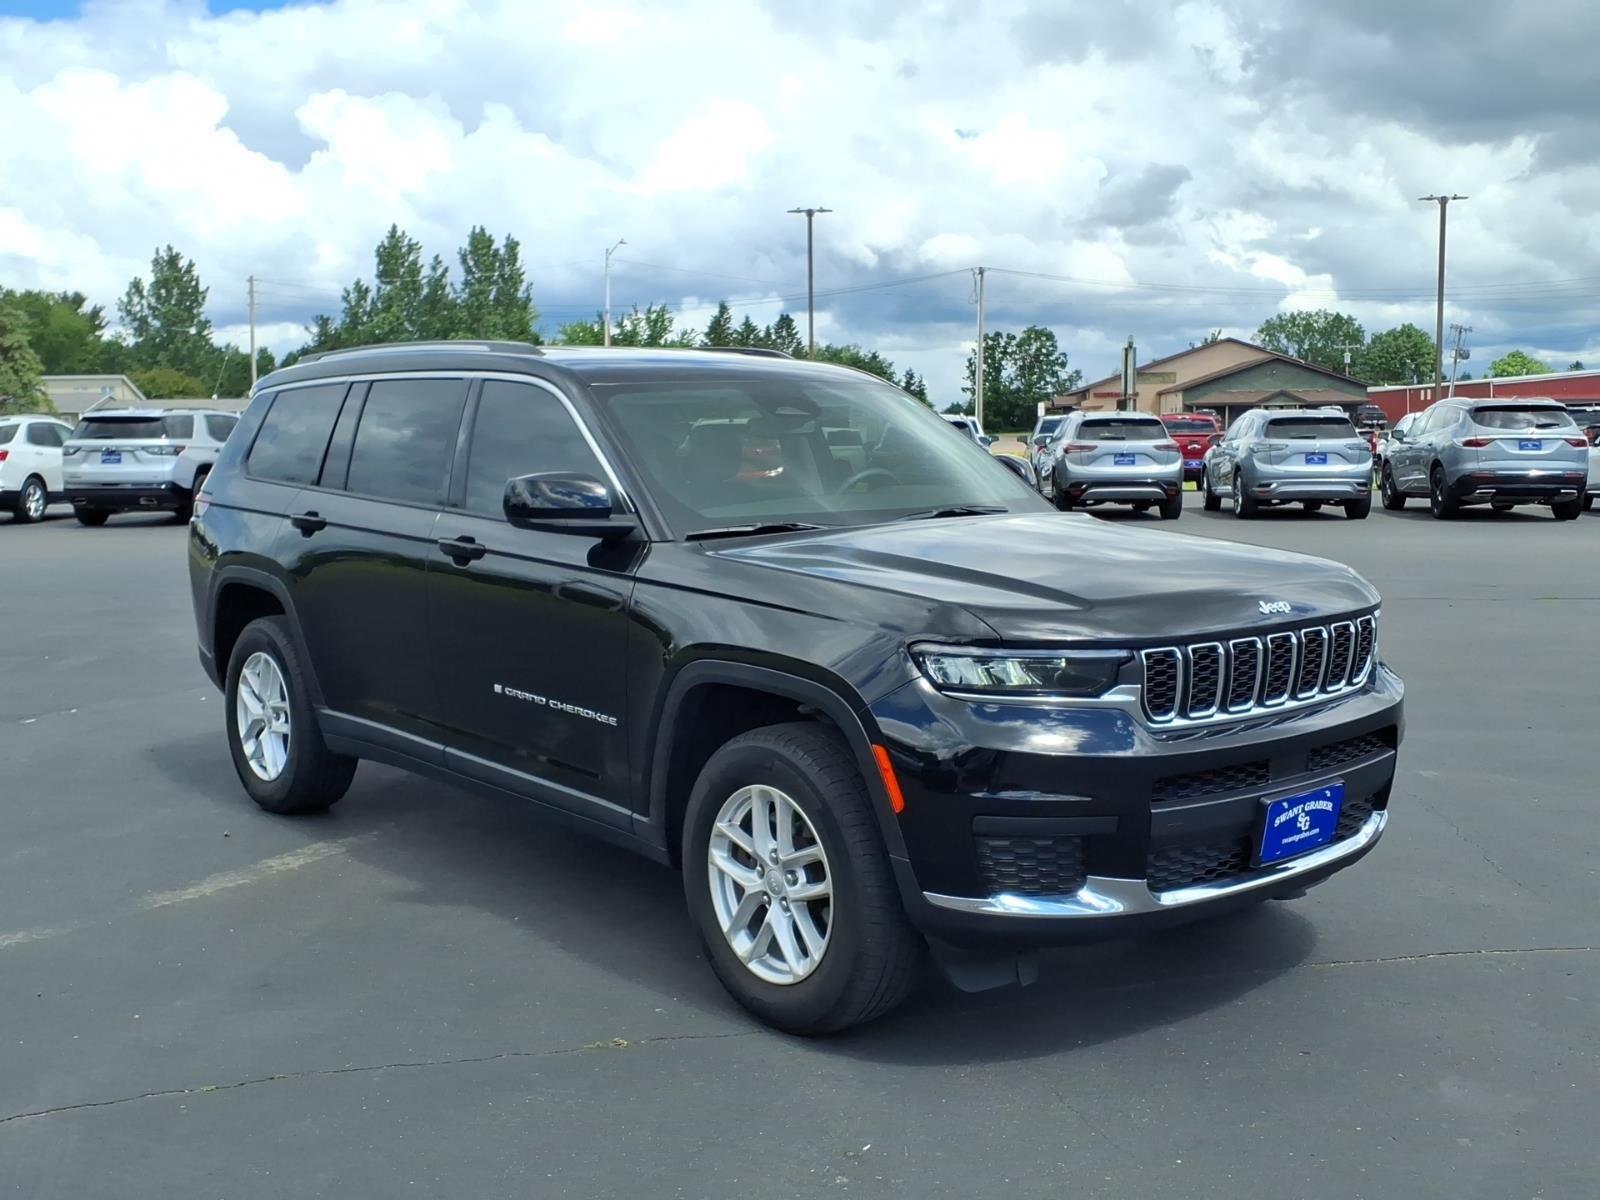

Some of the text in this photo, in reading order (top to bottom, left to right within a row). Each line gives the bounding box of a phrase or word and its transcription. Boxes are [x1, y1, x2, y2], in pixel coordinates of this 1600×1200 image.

[1258, 600, 1292, 614] Jeep
[504, 687, 618, 726] GRAND CHEROKEE
[1274, 800, 1333, 827] SWANT GRABER
[1297, 812, 1310, 830] SG
